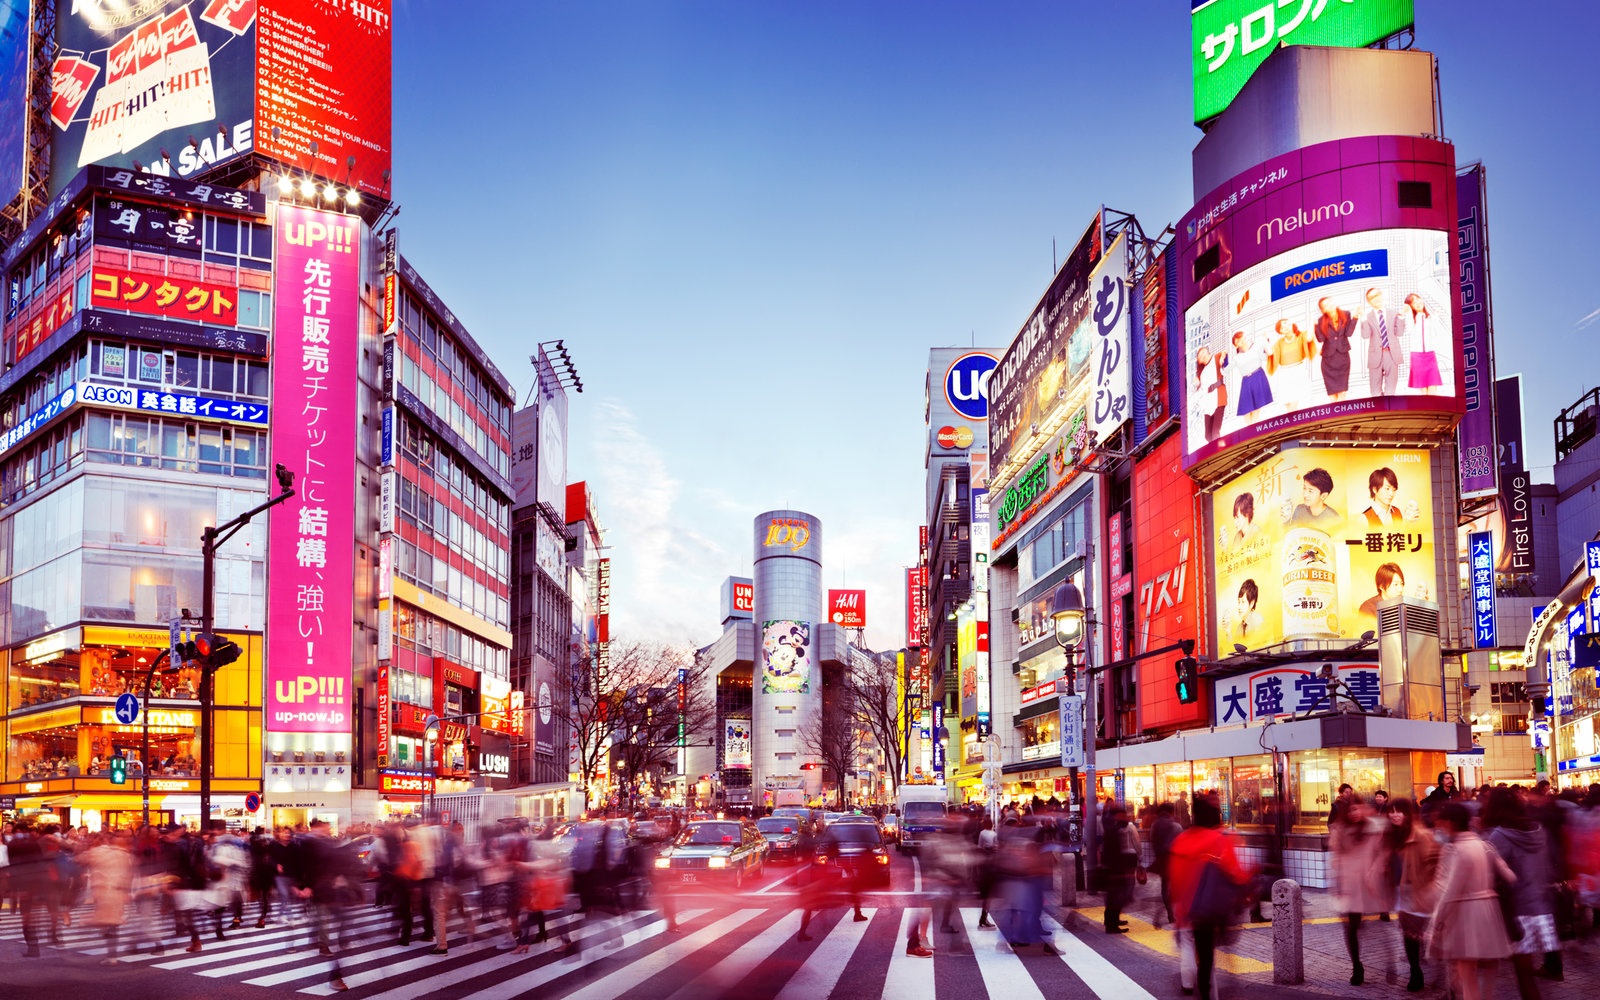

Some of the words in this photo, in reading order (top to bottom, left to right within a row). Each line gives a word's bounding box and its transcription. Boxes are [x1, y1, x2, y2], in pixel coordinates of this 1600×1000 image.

[259, 6, 272, 16] 01.
[272, 11, 305, 31] Everybody
[306, 25, 316, 35] Go
[259, 16, 272, 26] 02.
[272, 21, 285, 31] We
[285, 28, 303, 39] never
[350, 0, 389, 29] HIT!
[259, 26, 272, 37] 03.
[259, 37, 272, 47] 04.
[272, 41, 302, 59] WANNA
[259, 47, 272, 57] 05.
[272, 51, 291, 66] Shake
[259, 57, 271, 67] 06.
[258, 68, 271, 78] 07.
[258, 78, 271, 88] 08.
[272, 83, 283, 94] My
[90, 96, 126, 132] HIT!
[126, 81, 166, 116] HIT!
[166, 66, 210, 94] HIT!
[258, 110, 270, 120] 11.
[312, 130, 323, 139] On
[258, 120, 270, 129] 12.
[259, 99, 271, 109] 10.
[324, 124, 341, 136] KISS
[341, 131, 361, 143] YOUR
[361, 139, 381, 152] MIND
[178, 119, 253, 176] SALE
[258, 141, 270, 151] 14.
[110, 201, 123, 210] 9F
[1197, 192, 1238, 229] わかさ生活
[1240, 167, 1288, 200] チャンネル
[1284, 261, 1345, 290] PROMISE
[1349, 262, 1372, 273] プロミス
[94, 273, 235, 316] コンタクト
[1059, 279, 1077, 311] ALBUM
[17, 293, 74, 358] プライス
[89, 316, 102, 327] 7F
[163, 328, 188, 336] JAPANESE
[990, 307, 1047, 405] OLDCODEX
[1025, 339, 1052, 378] within
[1093, 275, 1127, 425] もんじゃ
[83, 386, 132, 405] AEON
[141, 393, 263, 420] 英会話イーオン
[1255, 417, 1290, 432] WAKASA
[1292, 407, 1331, 422] SEIKATSU
[1333, 401, 1376, 413] CHANNEL
[937, 432, 974, 443] MasterCard
[991, 403, 1021, 456] 2014.4.2
[1393, 454, 1421, 463] KIRIN
[1464, 455, 1489, 468] 3719
[1464, 466, 1490, 478] 2468
[1255, 457, 1298, 505] 新
[1511, 476, 1528, 523] Love
[762, 523, 811, 552] 109
[1345, 533, 1423, 553] 一番搾り
[1512, 526, 1530, 569] First
[1311, 569, 1334, 582] BEER
[835, 593, 858, 609] H&M
[1473, 541, 1493, 642] 大盛堂商事ビル
[844, 616, 862, 624] 150m
[909, 570, 920, 646] Essential
[275, 710, 345, 725] up-now.jp
[1063, 702, 1074, 756] 文化村通り
[479, 753, 509, 773] LUSH
